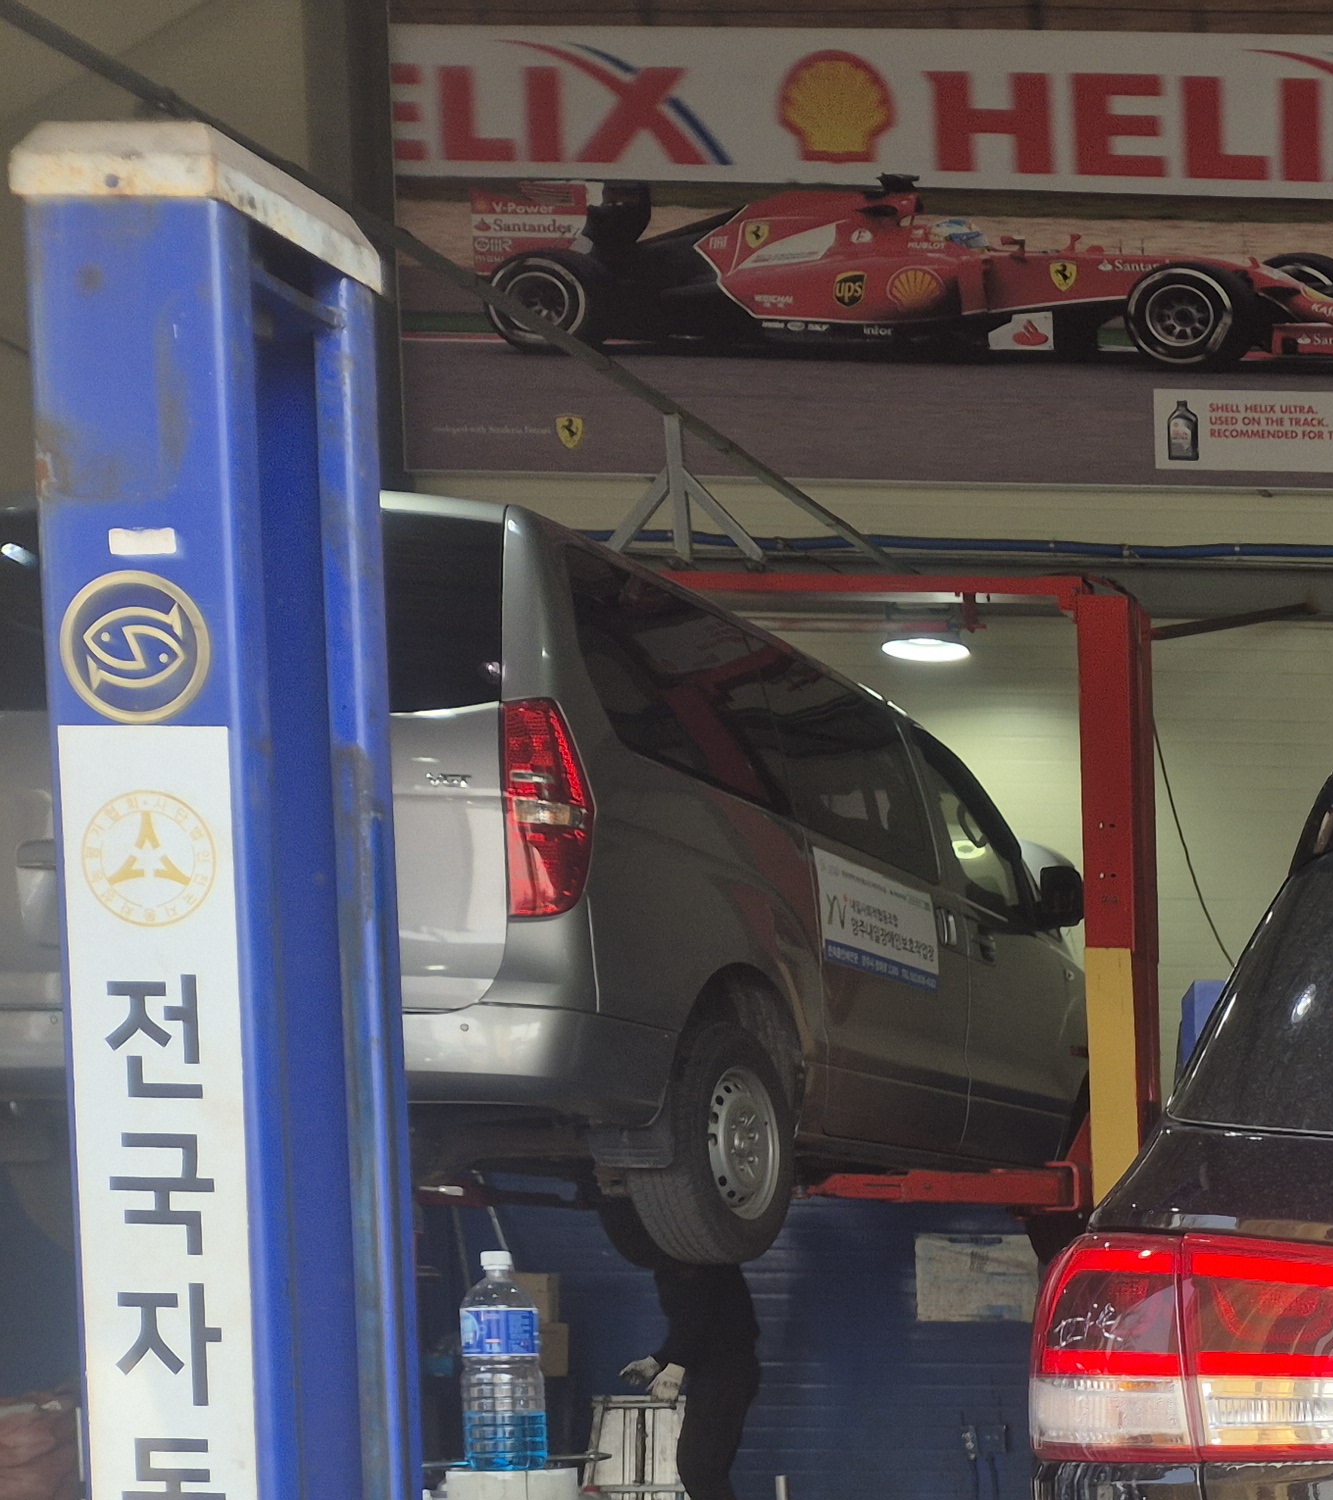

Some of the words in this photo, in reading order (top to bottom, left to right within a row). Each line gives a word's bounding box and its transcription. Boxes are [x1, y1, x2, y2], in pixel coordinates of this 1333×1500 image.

[491, 202, 554, 214] V-Power
[492, 219, 573, 234] Santander
[1114, 258, 1168, 273] Santa
[835, 280, 863, 298] ups
[1209, 402, 1241, 414] SHELL
[1244, 403, 1276, 415] HELIX
[1279, 404, 1318, 416] ULTRA.
[1209, 416, 1239, 427] USED
[1242, 416, 1261, 427] ON
[1264, 417, 1285, 428] THE
[1287, 417, 1329, 429] TRACK.
[1209, 428, 1299, 440] RECOMMENDED
[1301, 430, 1325, 441] FOR
